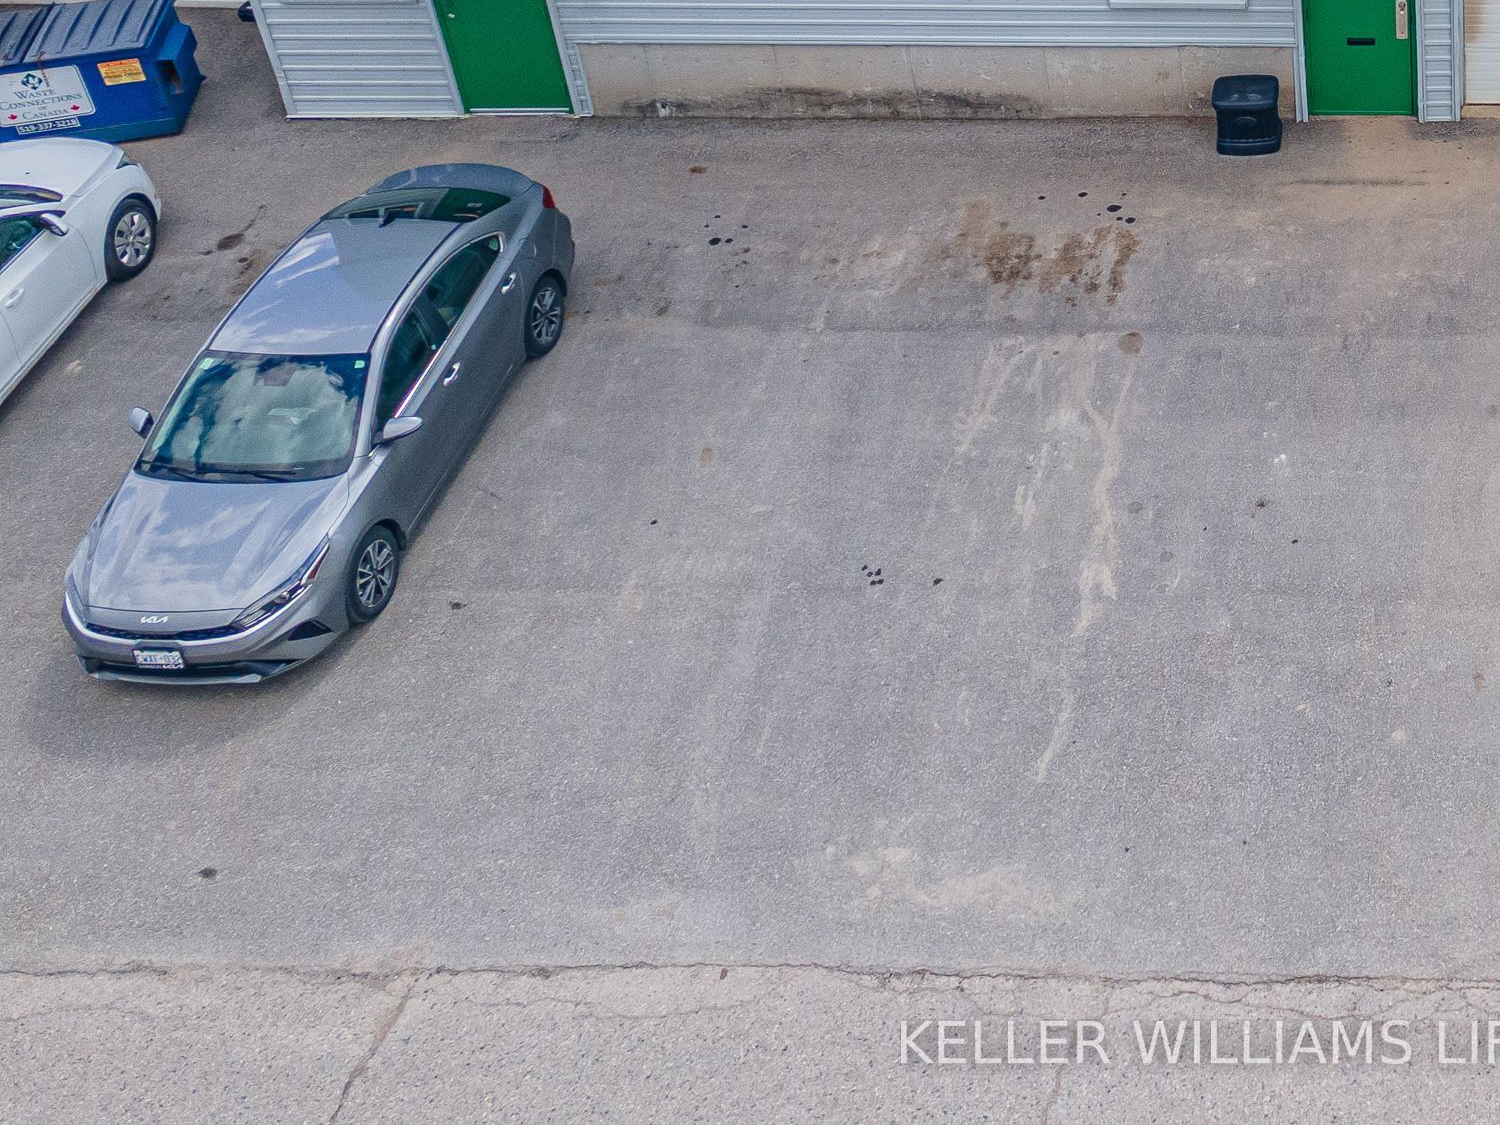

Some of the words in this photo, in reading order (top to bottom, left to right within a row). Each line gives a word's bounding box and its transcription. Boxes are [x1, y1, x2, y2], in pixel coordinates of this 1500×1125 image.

[14, 88, 57, 100] WASTE
[0, 93, 83, 111] CONNECTIONS
[22, 108, 70, 120] CANADA
